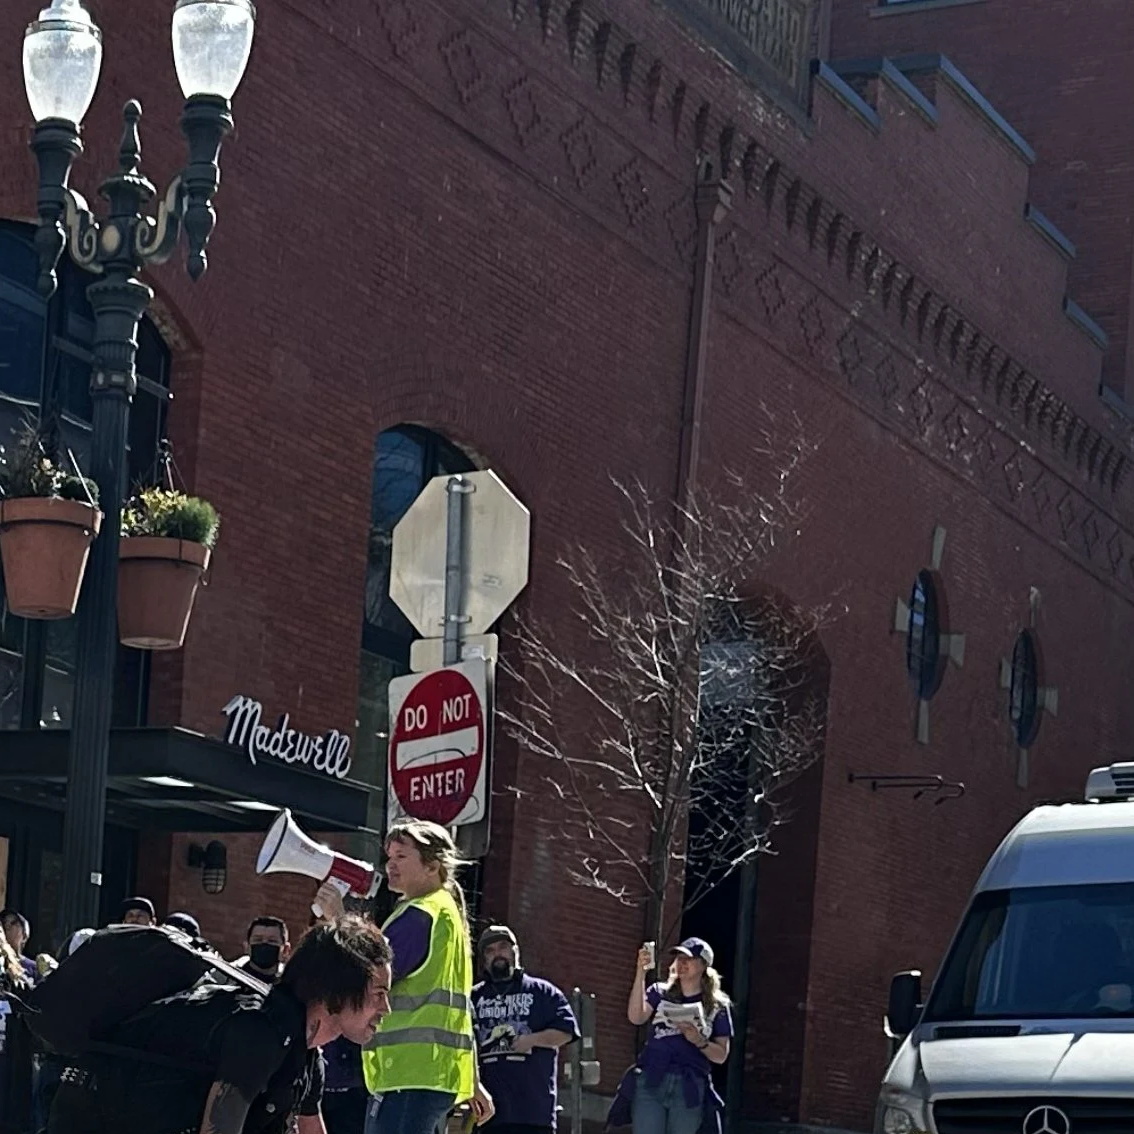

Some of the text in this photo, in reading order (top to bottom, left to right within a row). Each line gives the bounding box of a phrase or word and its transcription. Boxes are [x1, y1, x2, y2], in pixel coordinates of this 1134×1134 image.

[404, 693, 472, 732] DO NOT
[222, 695, 352, 778] Madewell
[410, 768, 465, 801] ENTER
